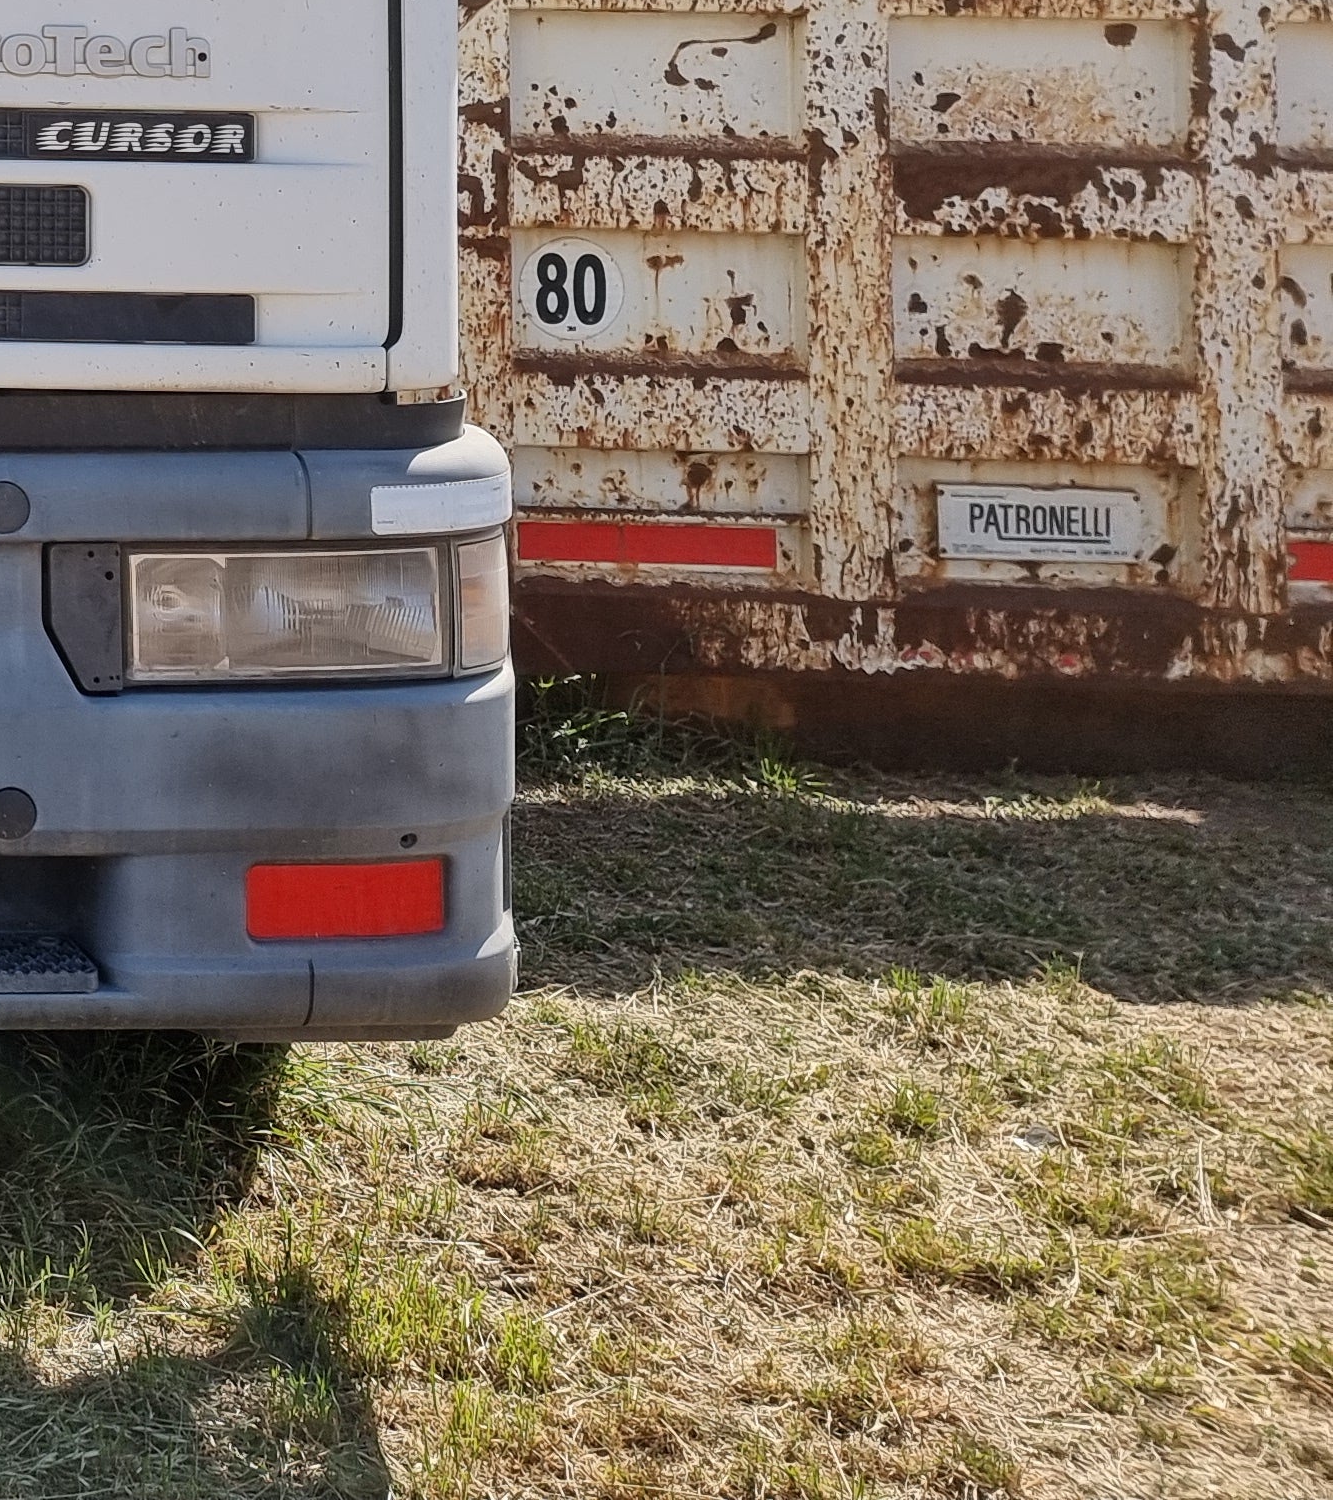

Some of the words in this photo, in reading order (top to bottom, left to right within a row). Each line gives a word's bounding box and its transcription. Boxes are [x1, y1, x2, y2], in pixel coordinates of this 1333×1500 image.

[35, 121, 246, 155] CURSOR
[536, 252, 607, 325] 80
[969, 503, 1111, 537] PATRONELLI
